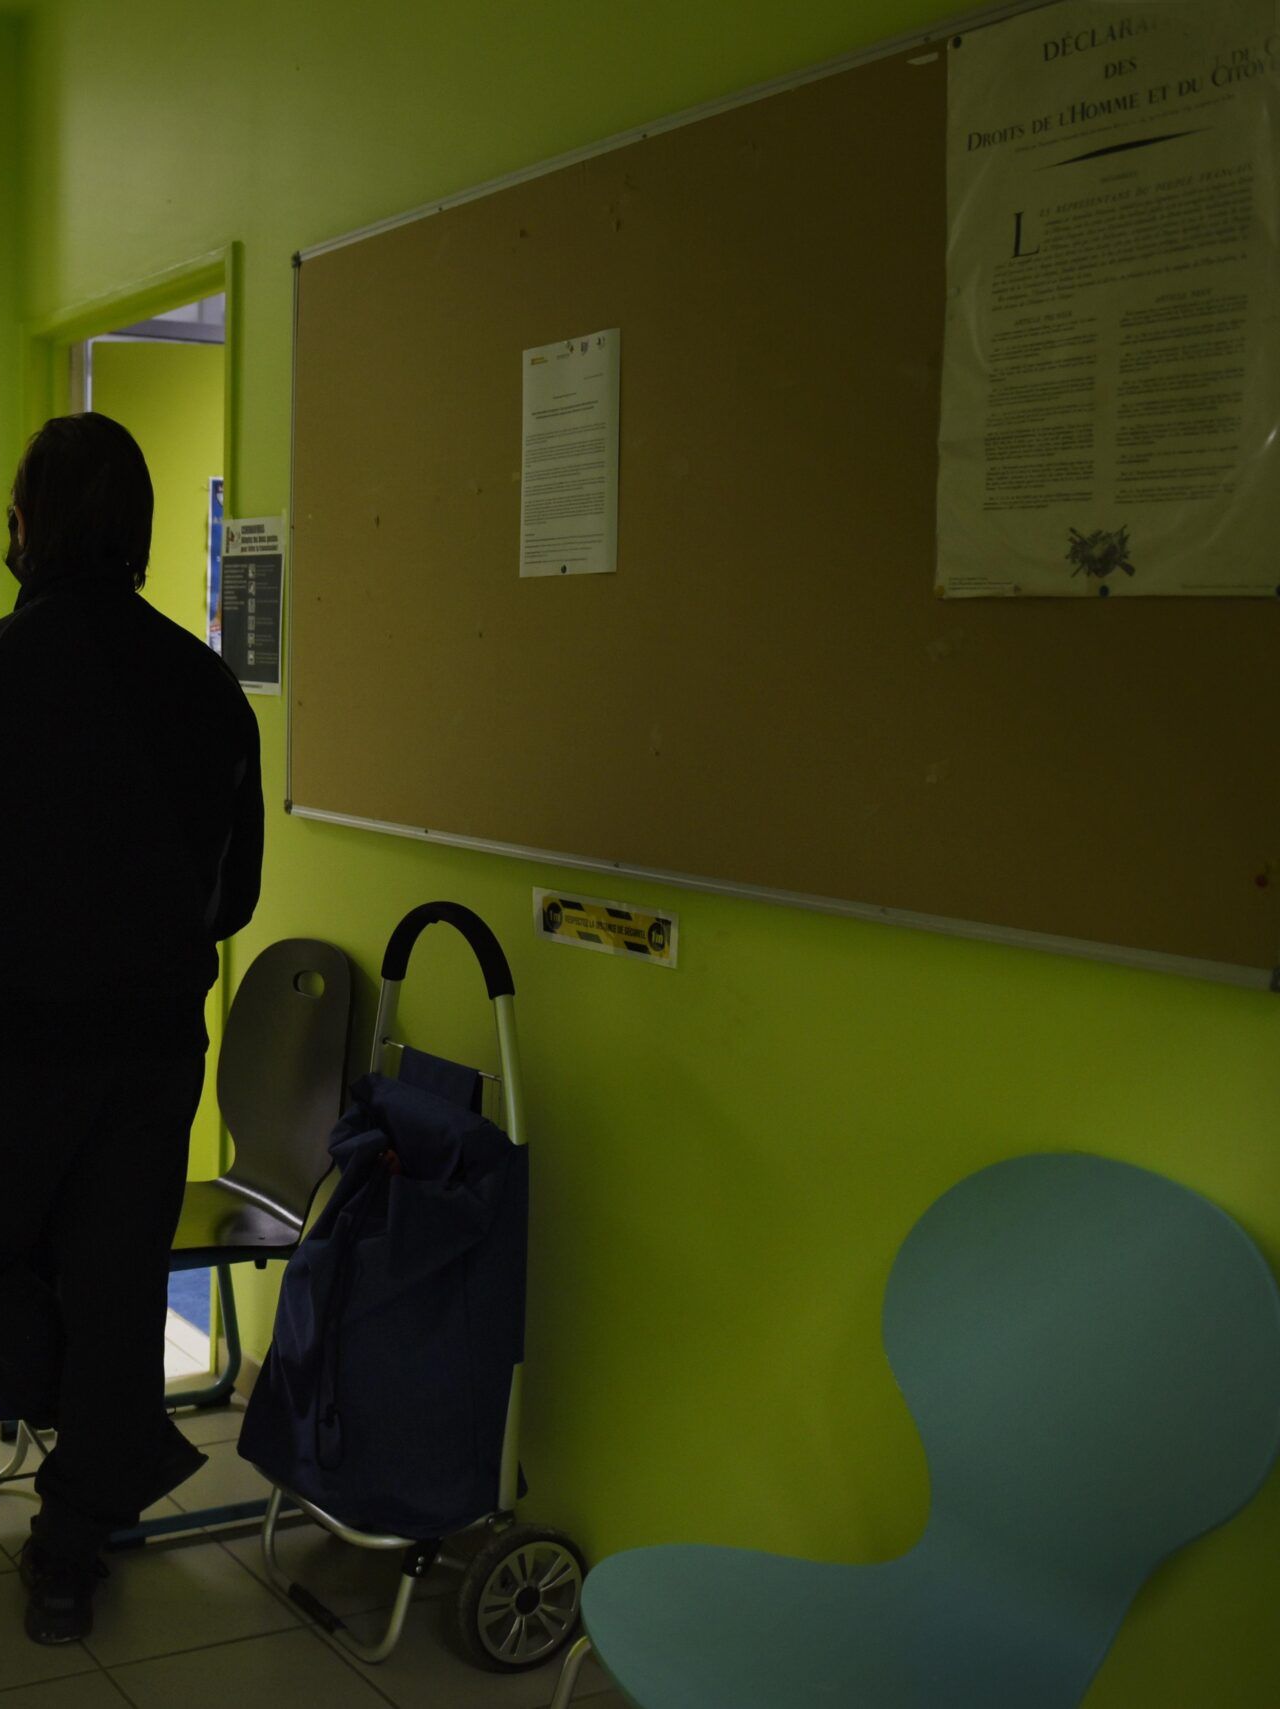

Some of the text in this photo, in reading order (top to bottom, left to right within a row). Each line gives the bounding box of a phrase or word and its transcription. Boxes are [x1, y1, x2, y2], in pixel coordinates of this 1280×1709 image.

[1103, 57, 1138, 79] DES
[966, 124, 1024, 152] DROITS
[1032, 115, 1053, 136] DE
[1148, 83, 1171, 105] ET
[1178, 77, 1204, 97] DU
